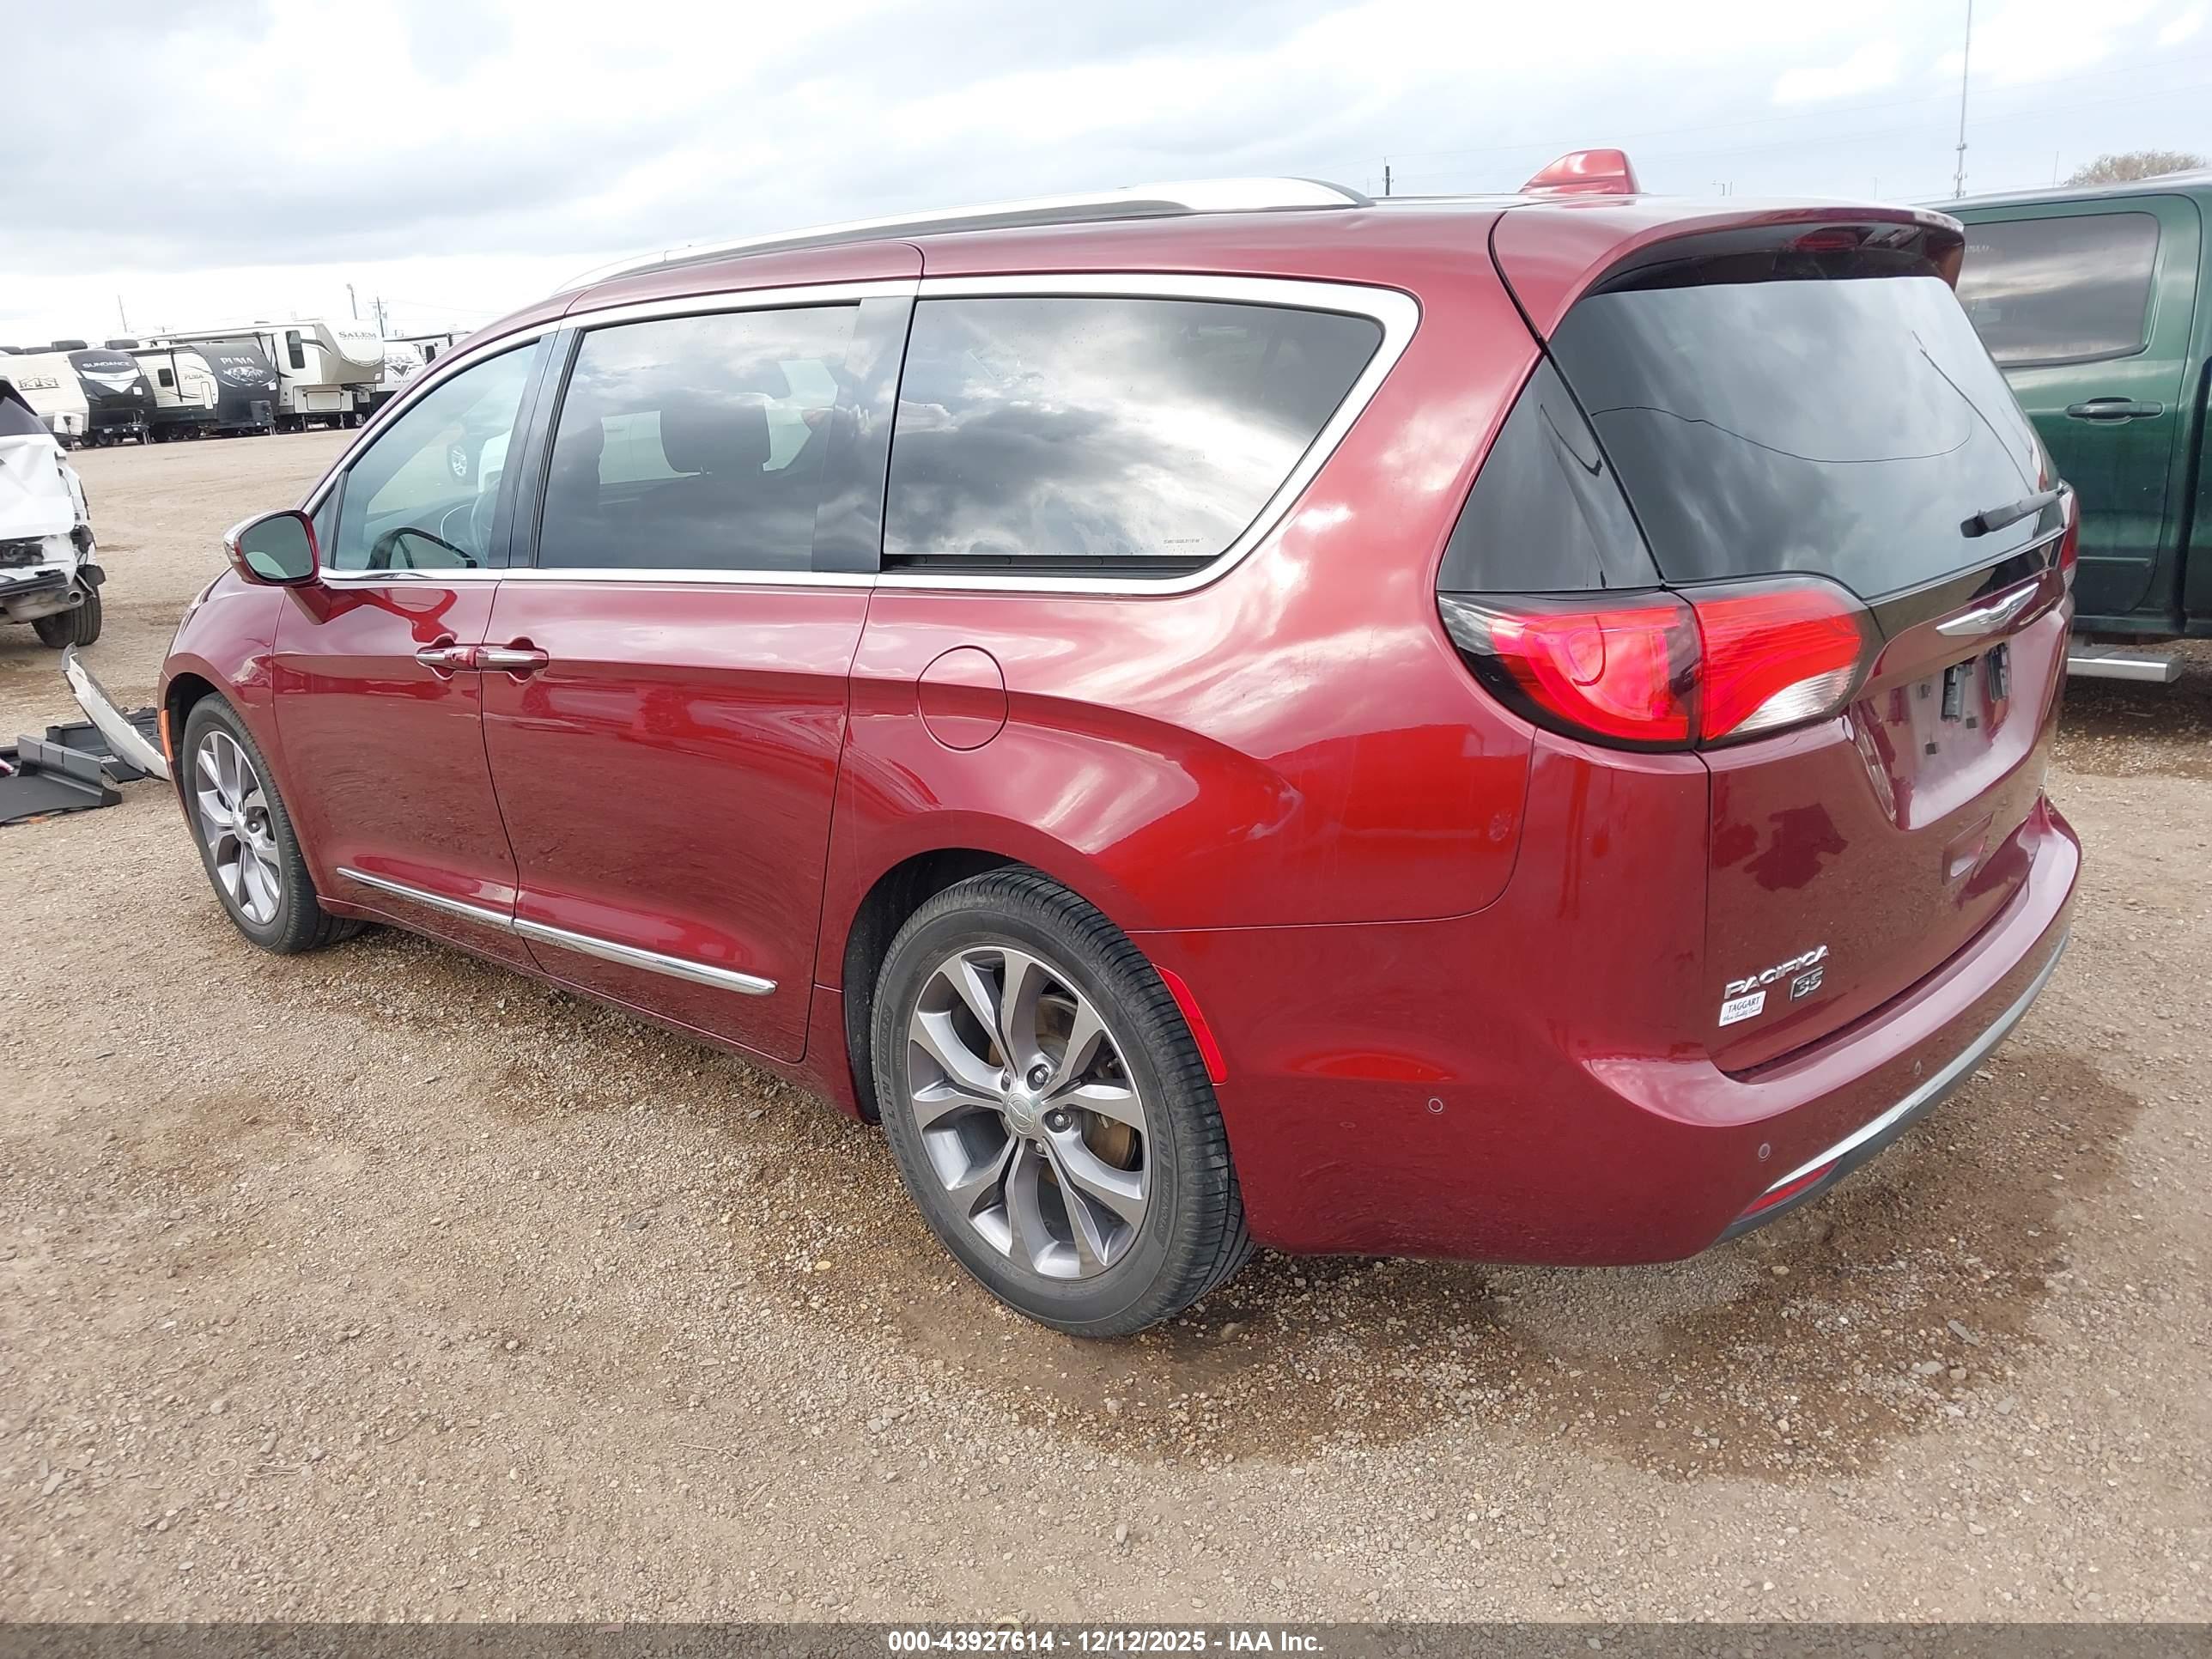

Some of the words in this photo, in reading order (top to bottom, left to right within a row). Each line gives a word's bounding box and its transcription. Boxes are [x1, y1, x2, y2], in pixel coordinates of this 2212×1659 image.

[338, 330, 378, 338] SALEM
[82, 361, 131, 369] SUNDANCE
[219, 356, 255, 365] PUMA
[1723, 945, 1829, 1000] PACIFICA
[1793, 970, 1824, 999] 35
[1728, 995, 1761, 1013] TAGGART
